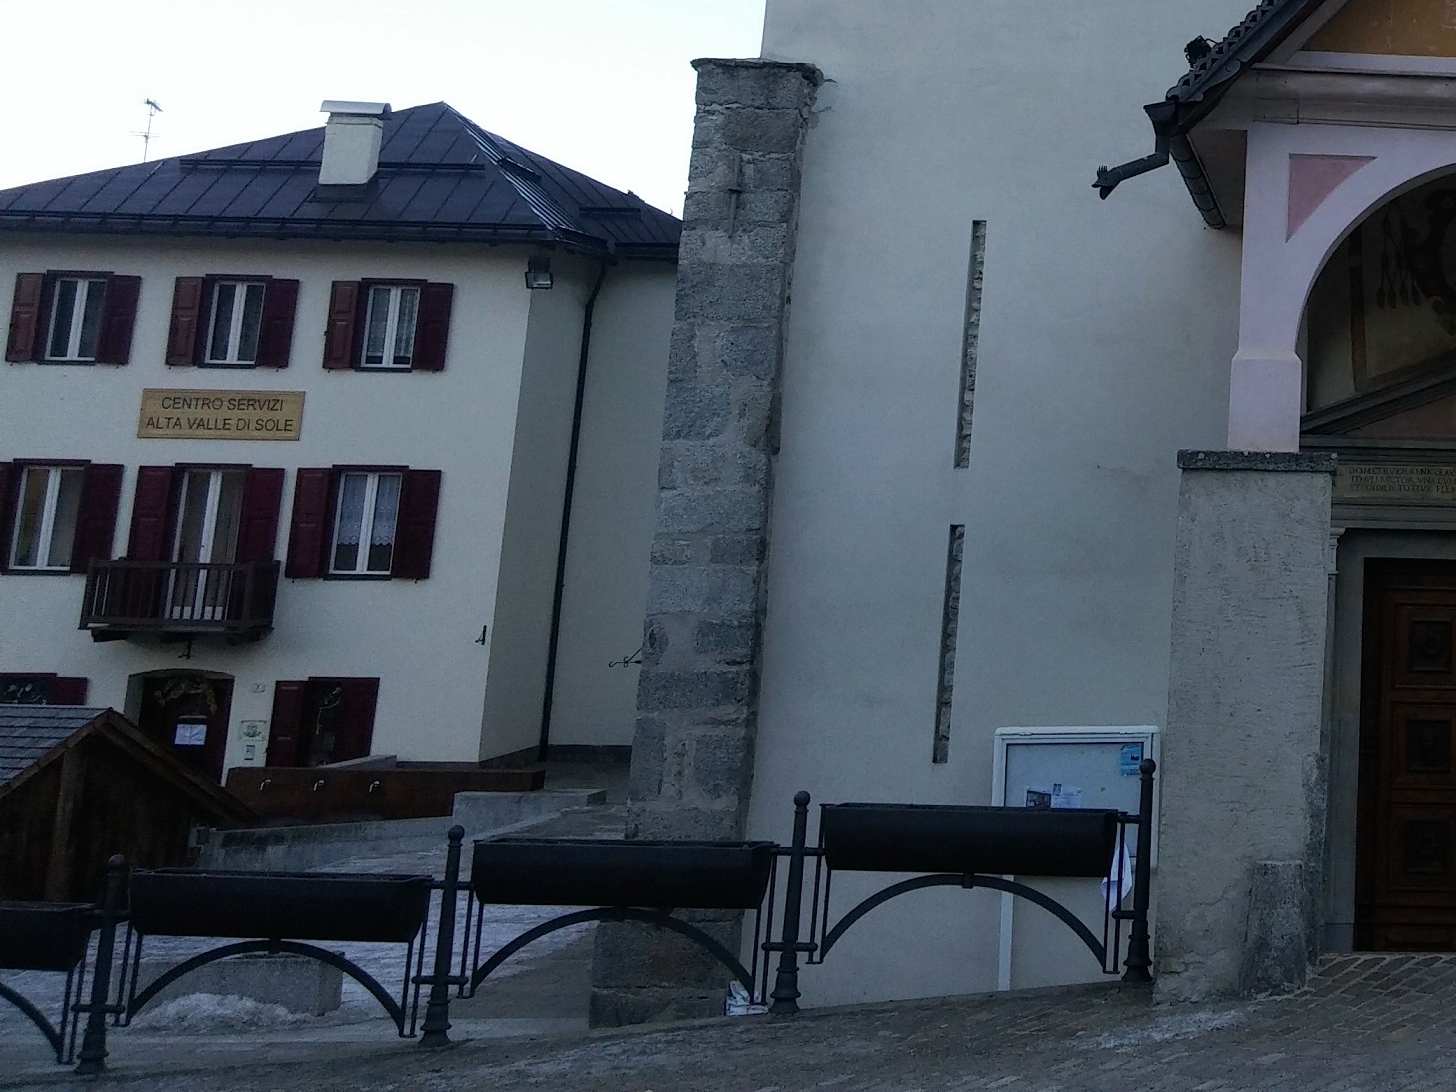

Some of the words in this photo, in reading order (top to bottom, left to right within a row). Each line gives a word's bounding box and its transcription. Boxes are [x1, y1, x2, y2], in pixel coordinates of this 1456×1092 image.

[161, 396, 223, 411] CENTRO
[227, 398, 284, 412] SERVIZI
[146, 416, 183, 430] ALTA
[187, 417, 232, 431] VALLE
[236, 418, 251, 431] DI
[255, 418, 294, 432] SOLE
